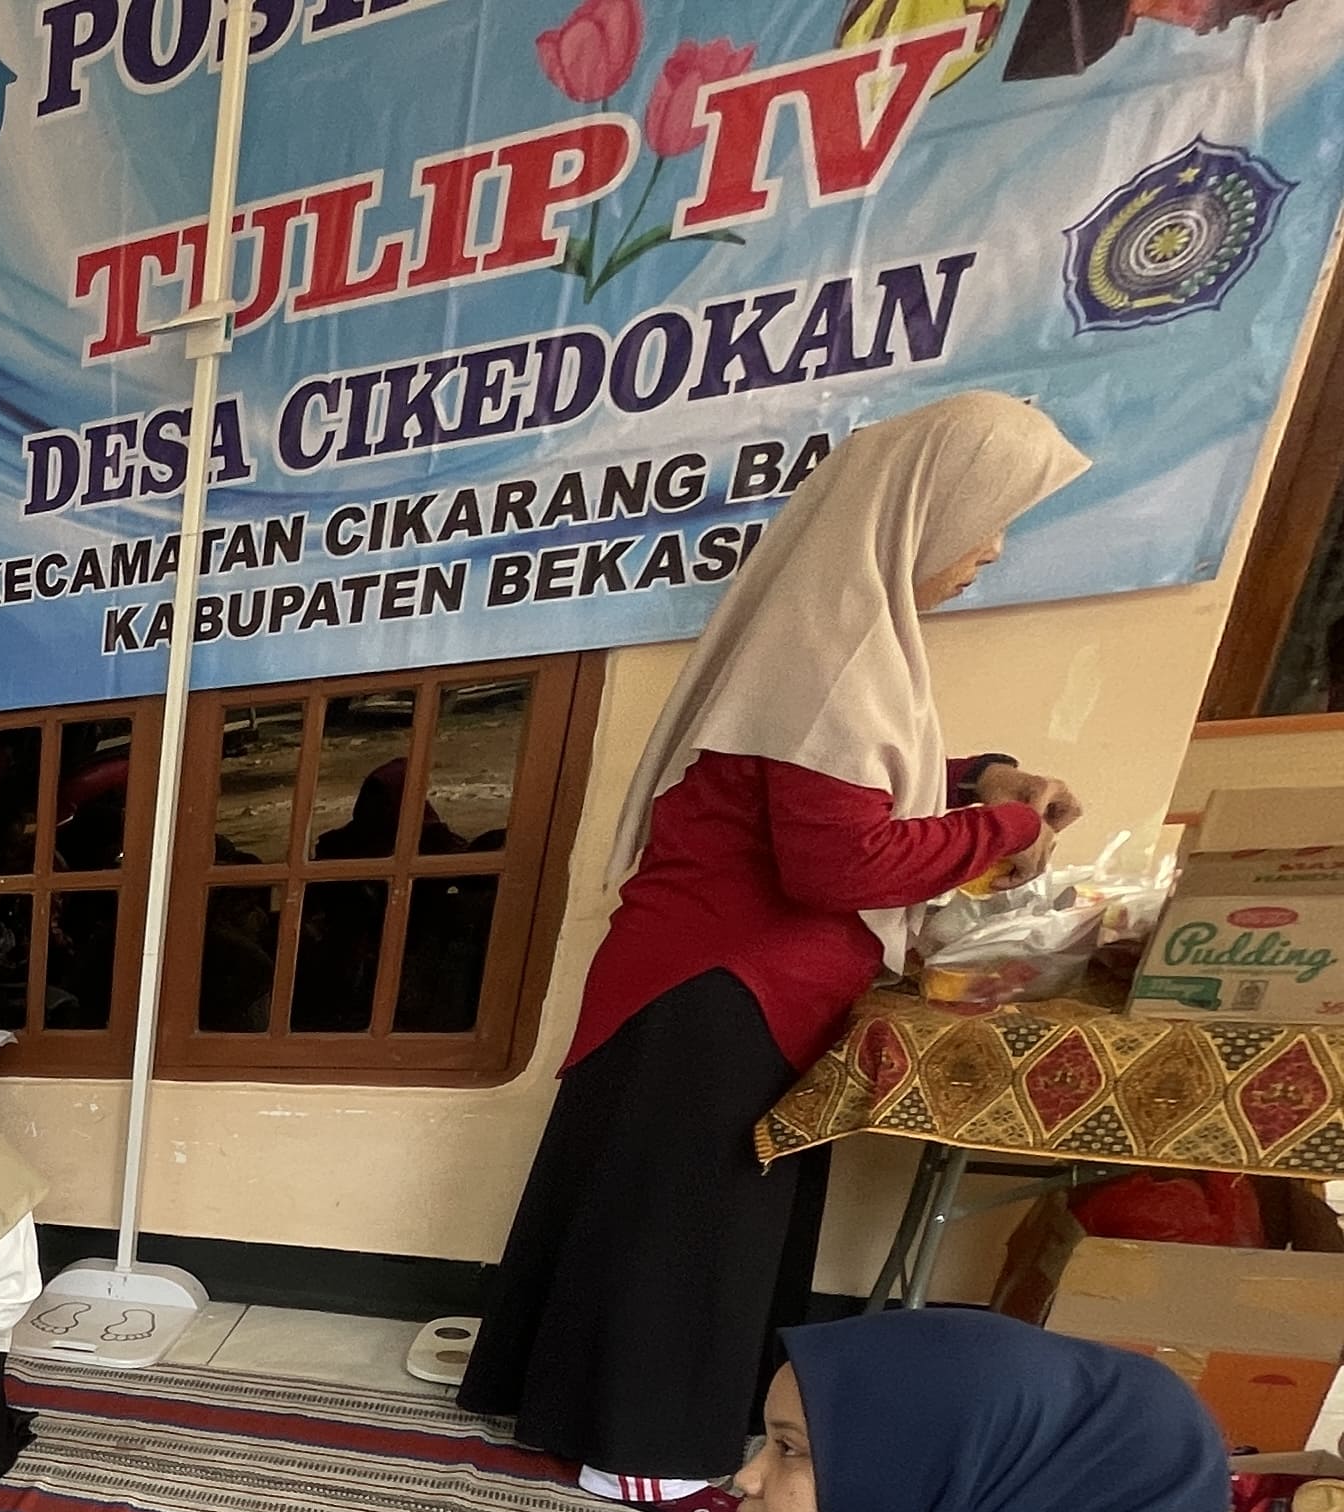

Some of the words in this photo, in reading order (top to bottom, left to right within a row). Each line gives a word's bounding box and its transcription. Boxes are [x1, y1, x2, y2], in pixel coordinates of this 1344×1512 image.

[75, 122, 637, 357] TULIP
[682, 27, 968, 227] IV
[24, 398, 251, 515] DESA
[278, 252, 977, 471] CIKEDOKAN
[326, 453, 707, 556] CIKARANG
[103, 562, 468, 653] KABUPATEN
[1164, 921, 1339, 983] Pudding
